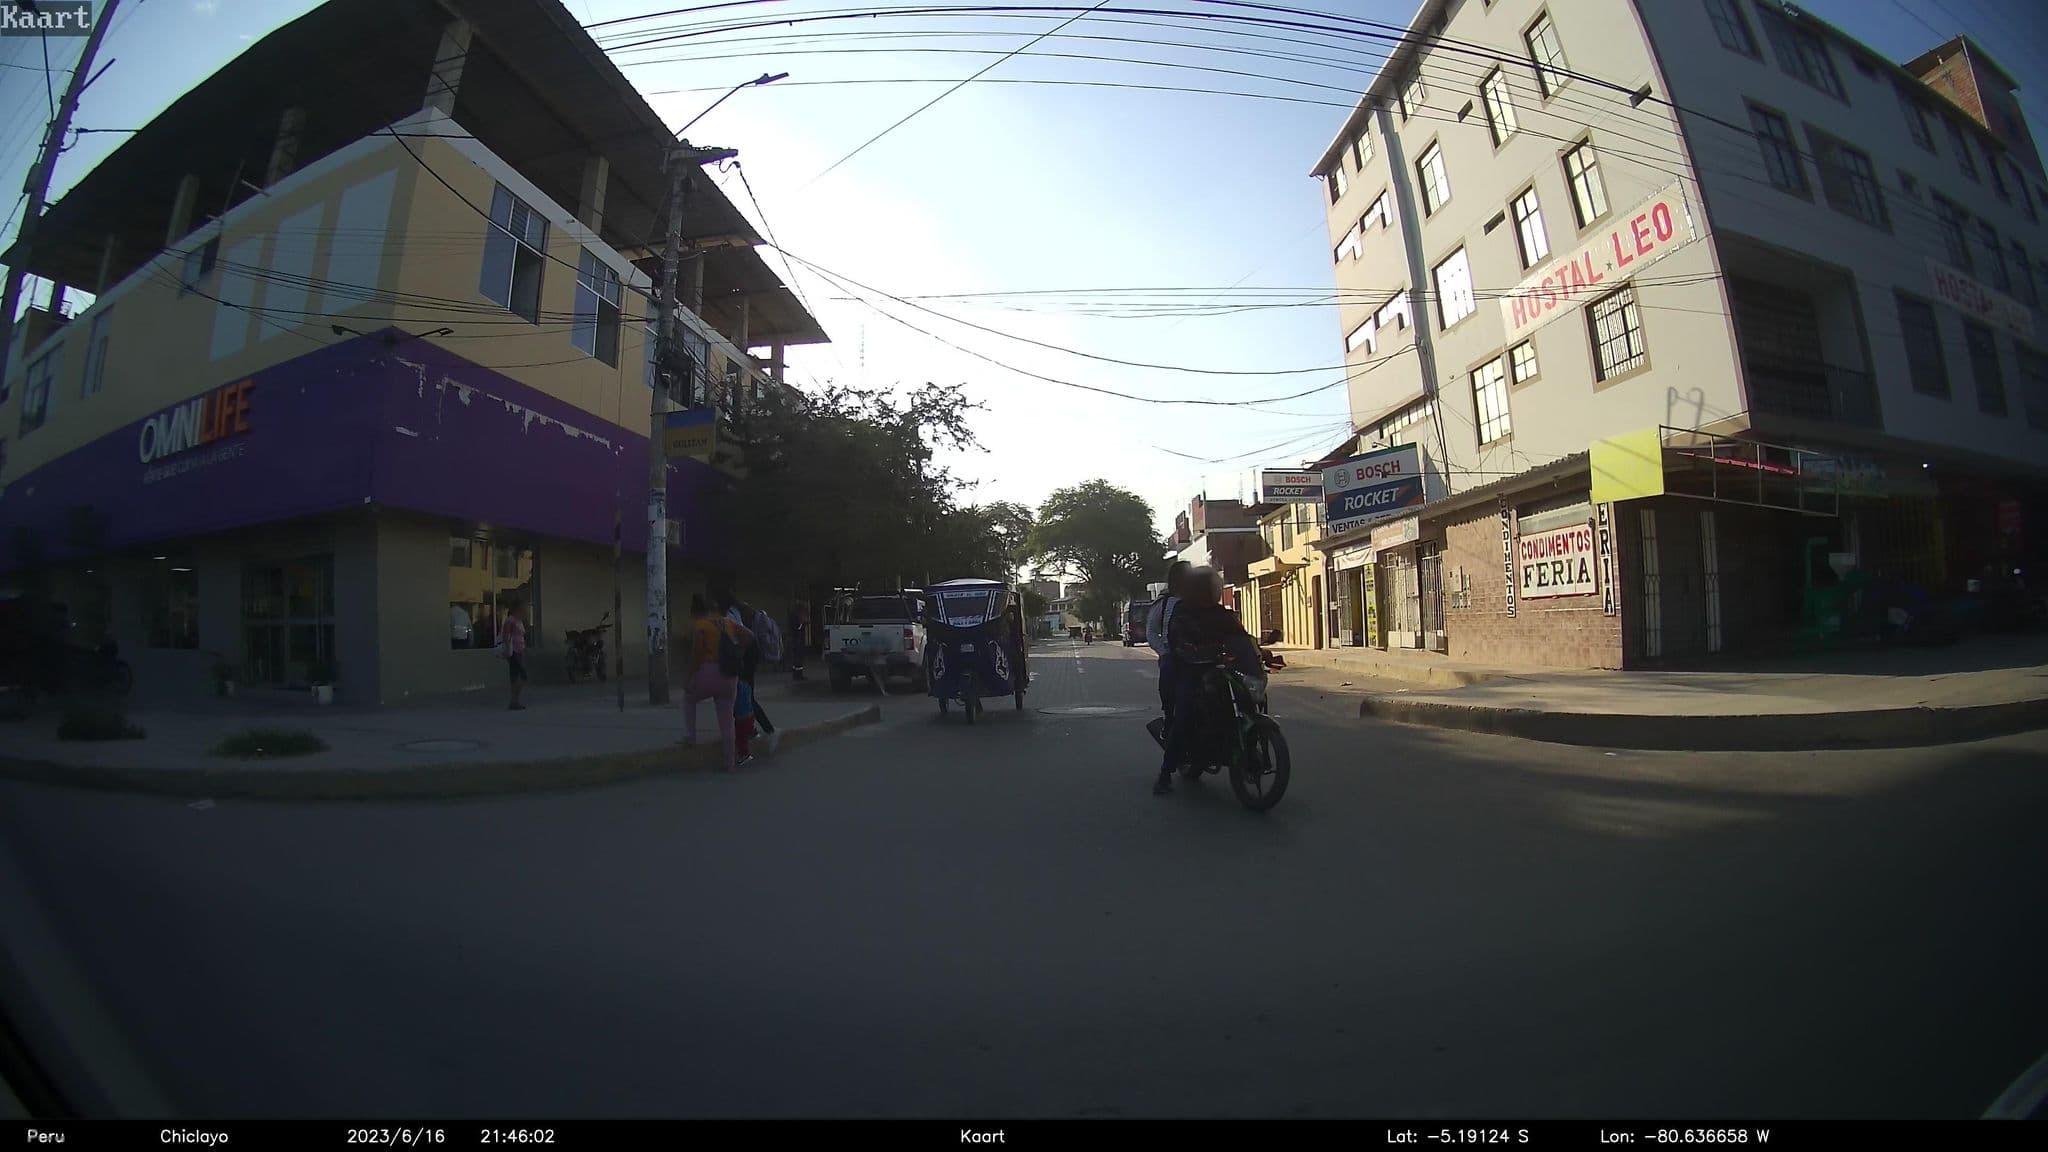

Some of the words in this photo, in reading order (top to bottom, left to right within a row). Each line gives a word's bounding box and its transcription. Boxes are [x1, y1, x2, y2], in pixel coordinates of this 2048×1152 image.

[1511, 250, 1604, 329] HOSTAL
[1611, 202, 1673, 268] LEO
[140, 378, 256, 464] OMNILIFE
[1285, 475, 1311, 484] BOSCH
[1355, 460, 1400, 481] BOSCH
[1273, 487, 1305, 495] ROCKET
[1344, 487, 1399, 512] ROCKET
[1521, 529, 1591, 561] CONDIMENTOS
[1598, 503, 1614, 614] ERIA
[1523, 557, 1592, 588] FERIA
